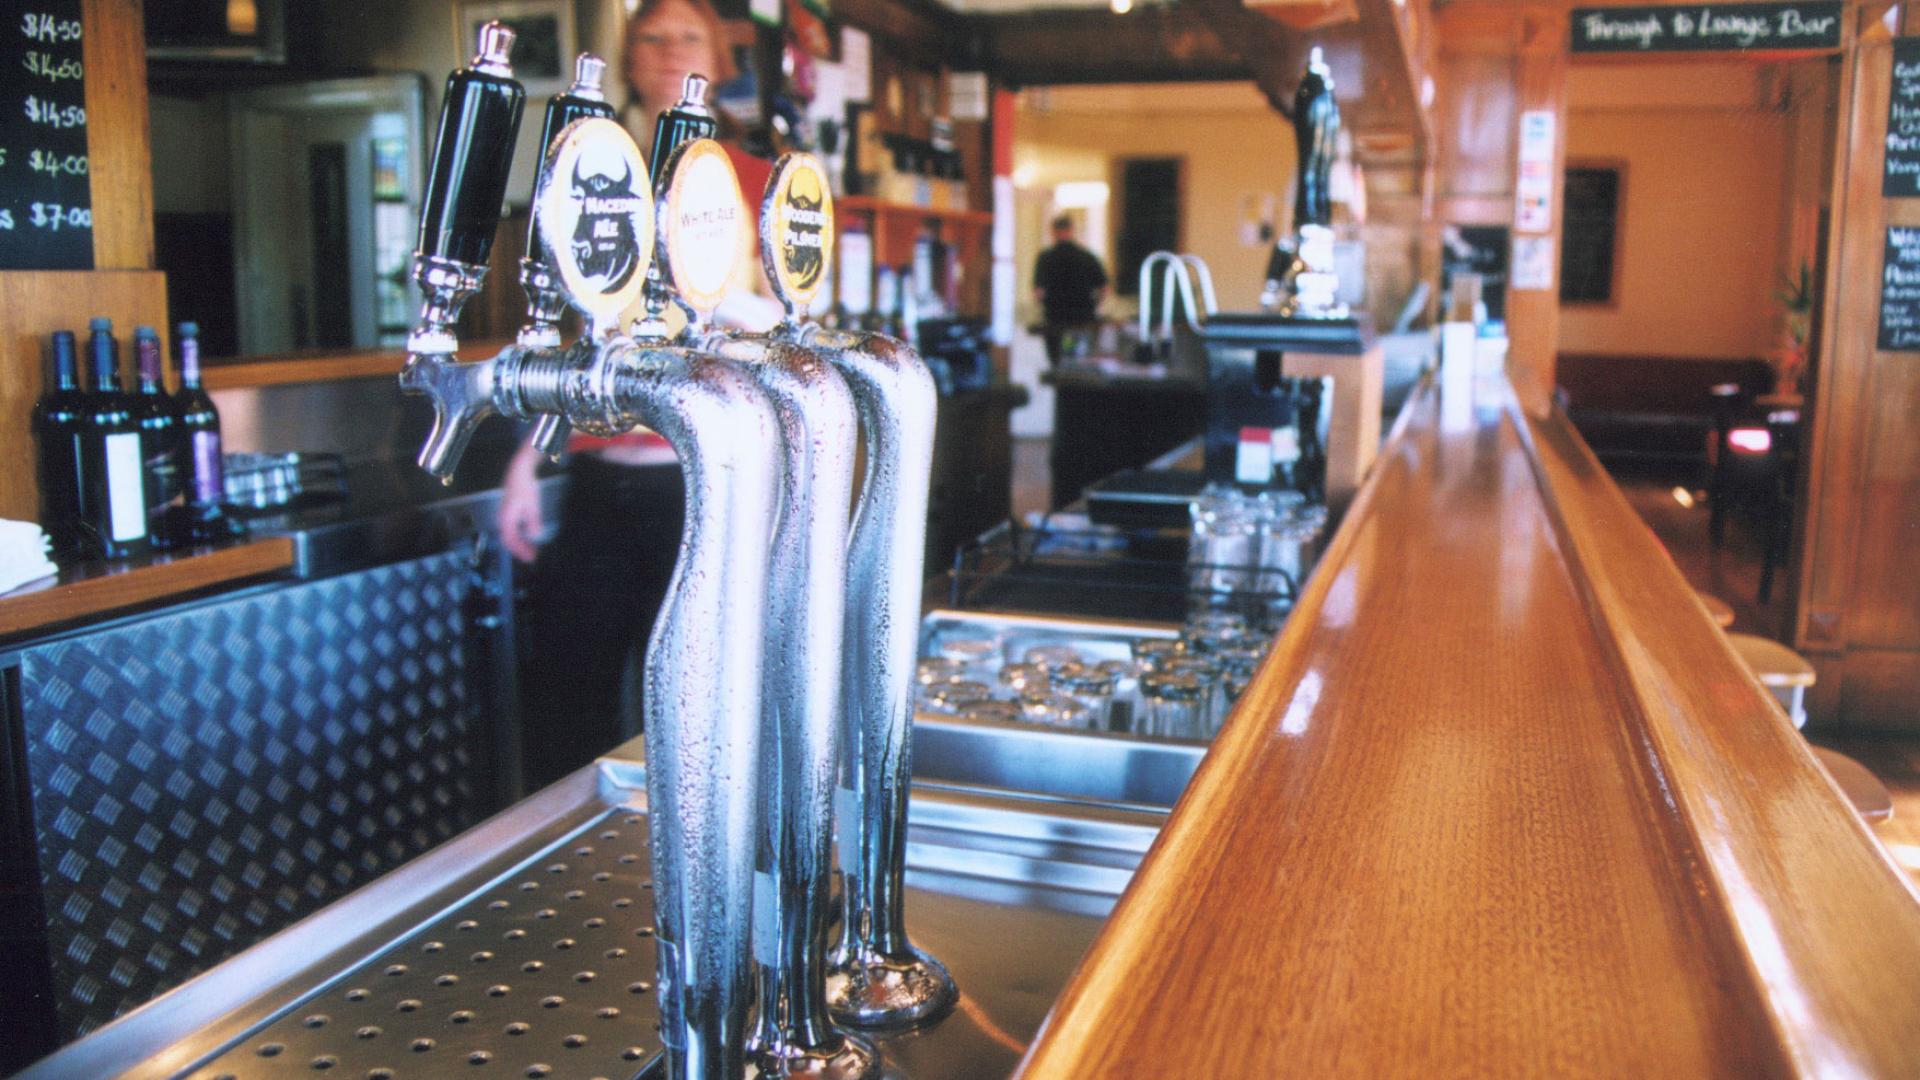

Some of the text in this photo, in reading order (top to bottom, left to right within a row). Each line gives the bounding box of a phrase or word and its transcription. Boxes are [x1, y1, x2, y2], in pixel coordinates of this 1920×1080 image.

[1583, 13, 1662, 49] Through
[1698, 8, 1770, 47] Lounge
[1777, 9, 1835, 38] Bar
[25, 95, 86, 128] $14.50
[593, 218, 619, 238] ALE
